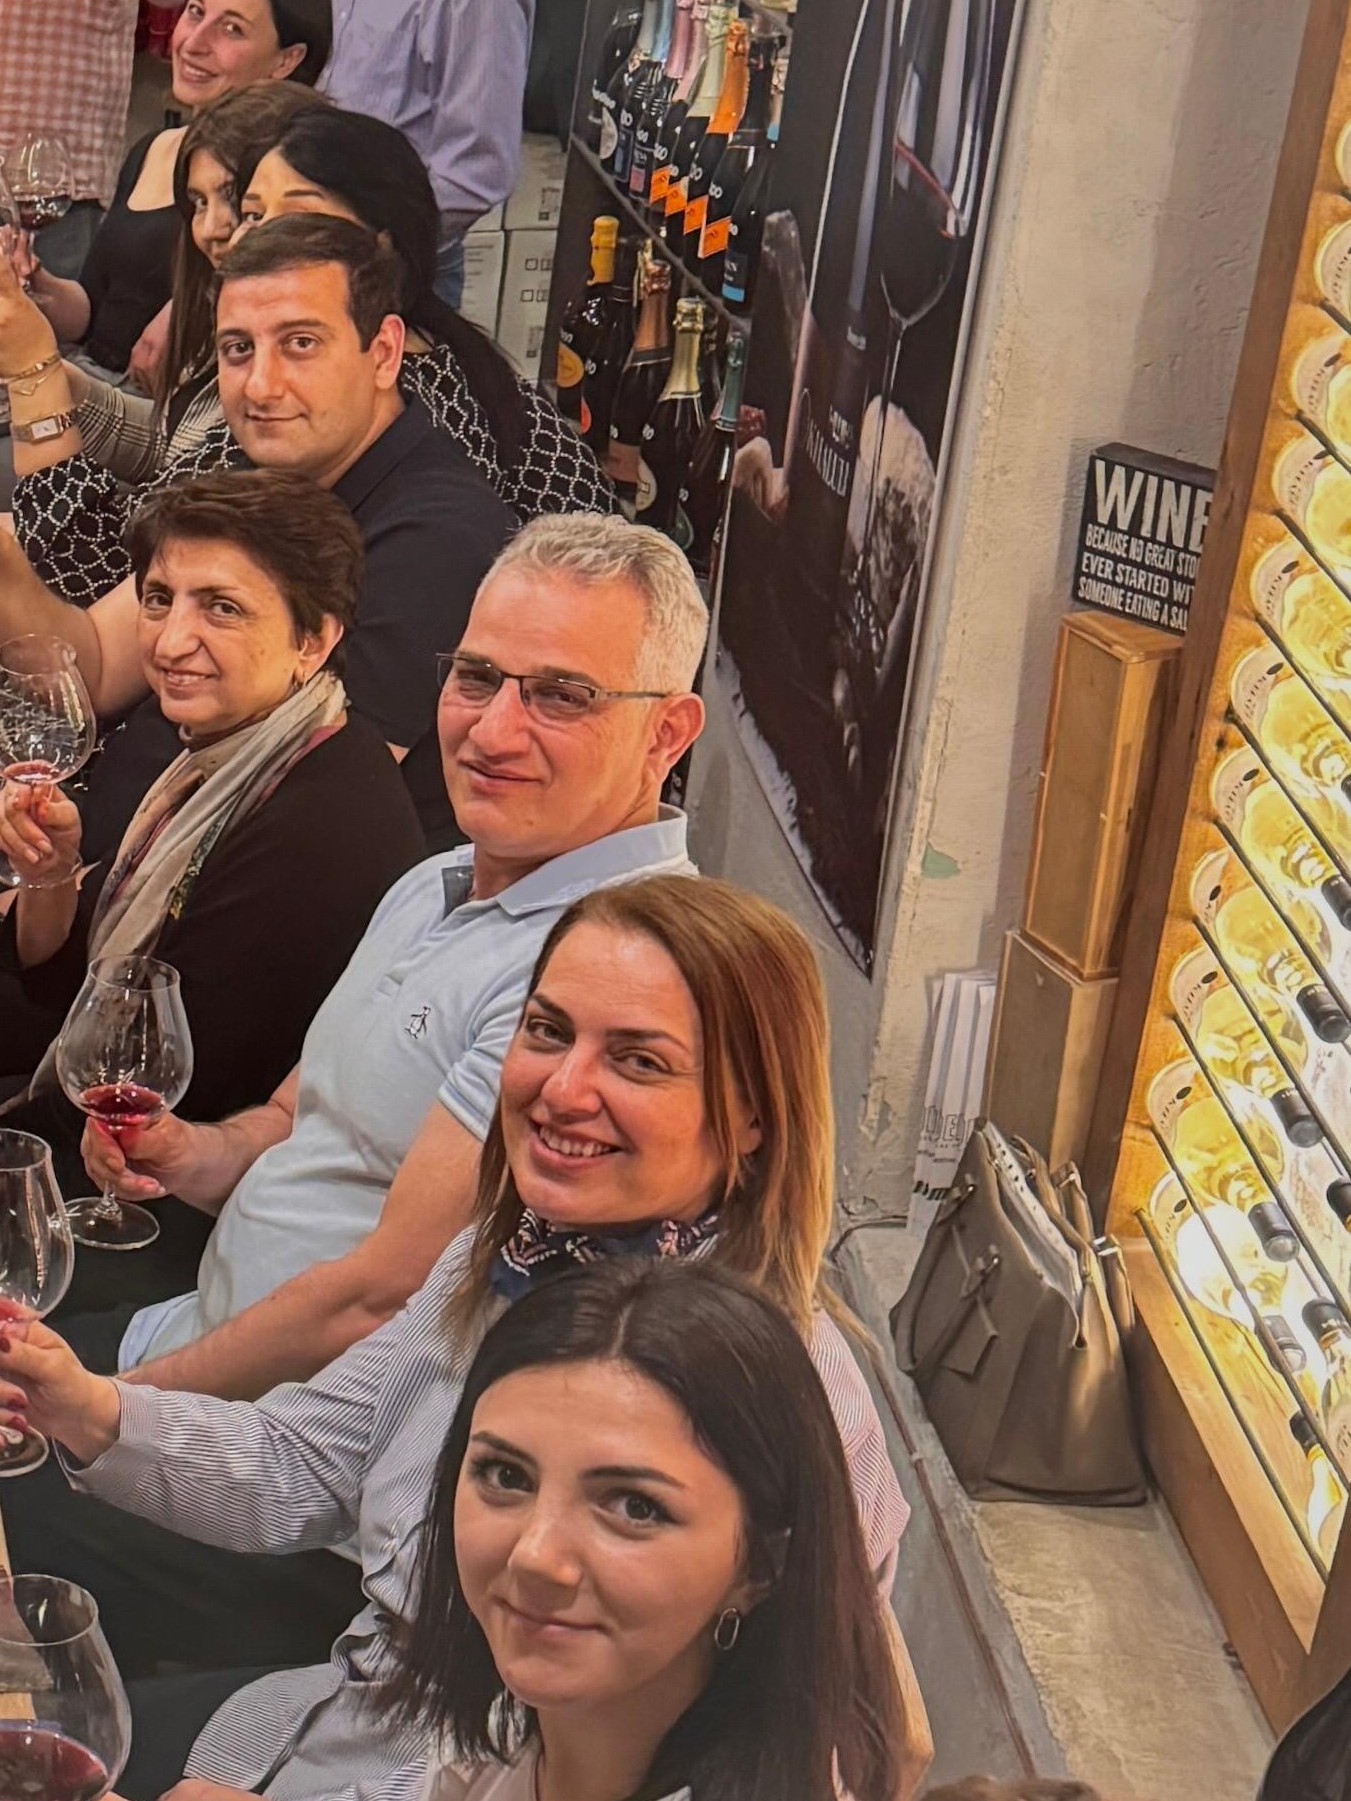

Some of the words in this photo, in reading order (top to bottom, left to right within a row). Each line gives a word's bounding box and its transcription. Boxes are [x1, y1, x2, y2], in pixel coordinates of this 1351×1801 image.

[1085, 523, 1129, 558] BECAUSE
[1129, 537, 1143, 562] NO
[1144, 542, 1176, 572] GREAT
[1082, 552, 1114, 580] EVER
[1115, 564, 1169, 597] STARTED
[1078, 576, 1124, 611] SOMEONE
[1125, 592, 1160, 621] EATING
[1160, 604, 1169, 625] A
